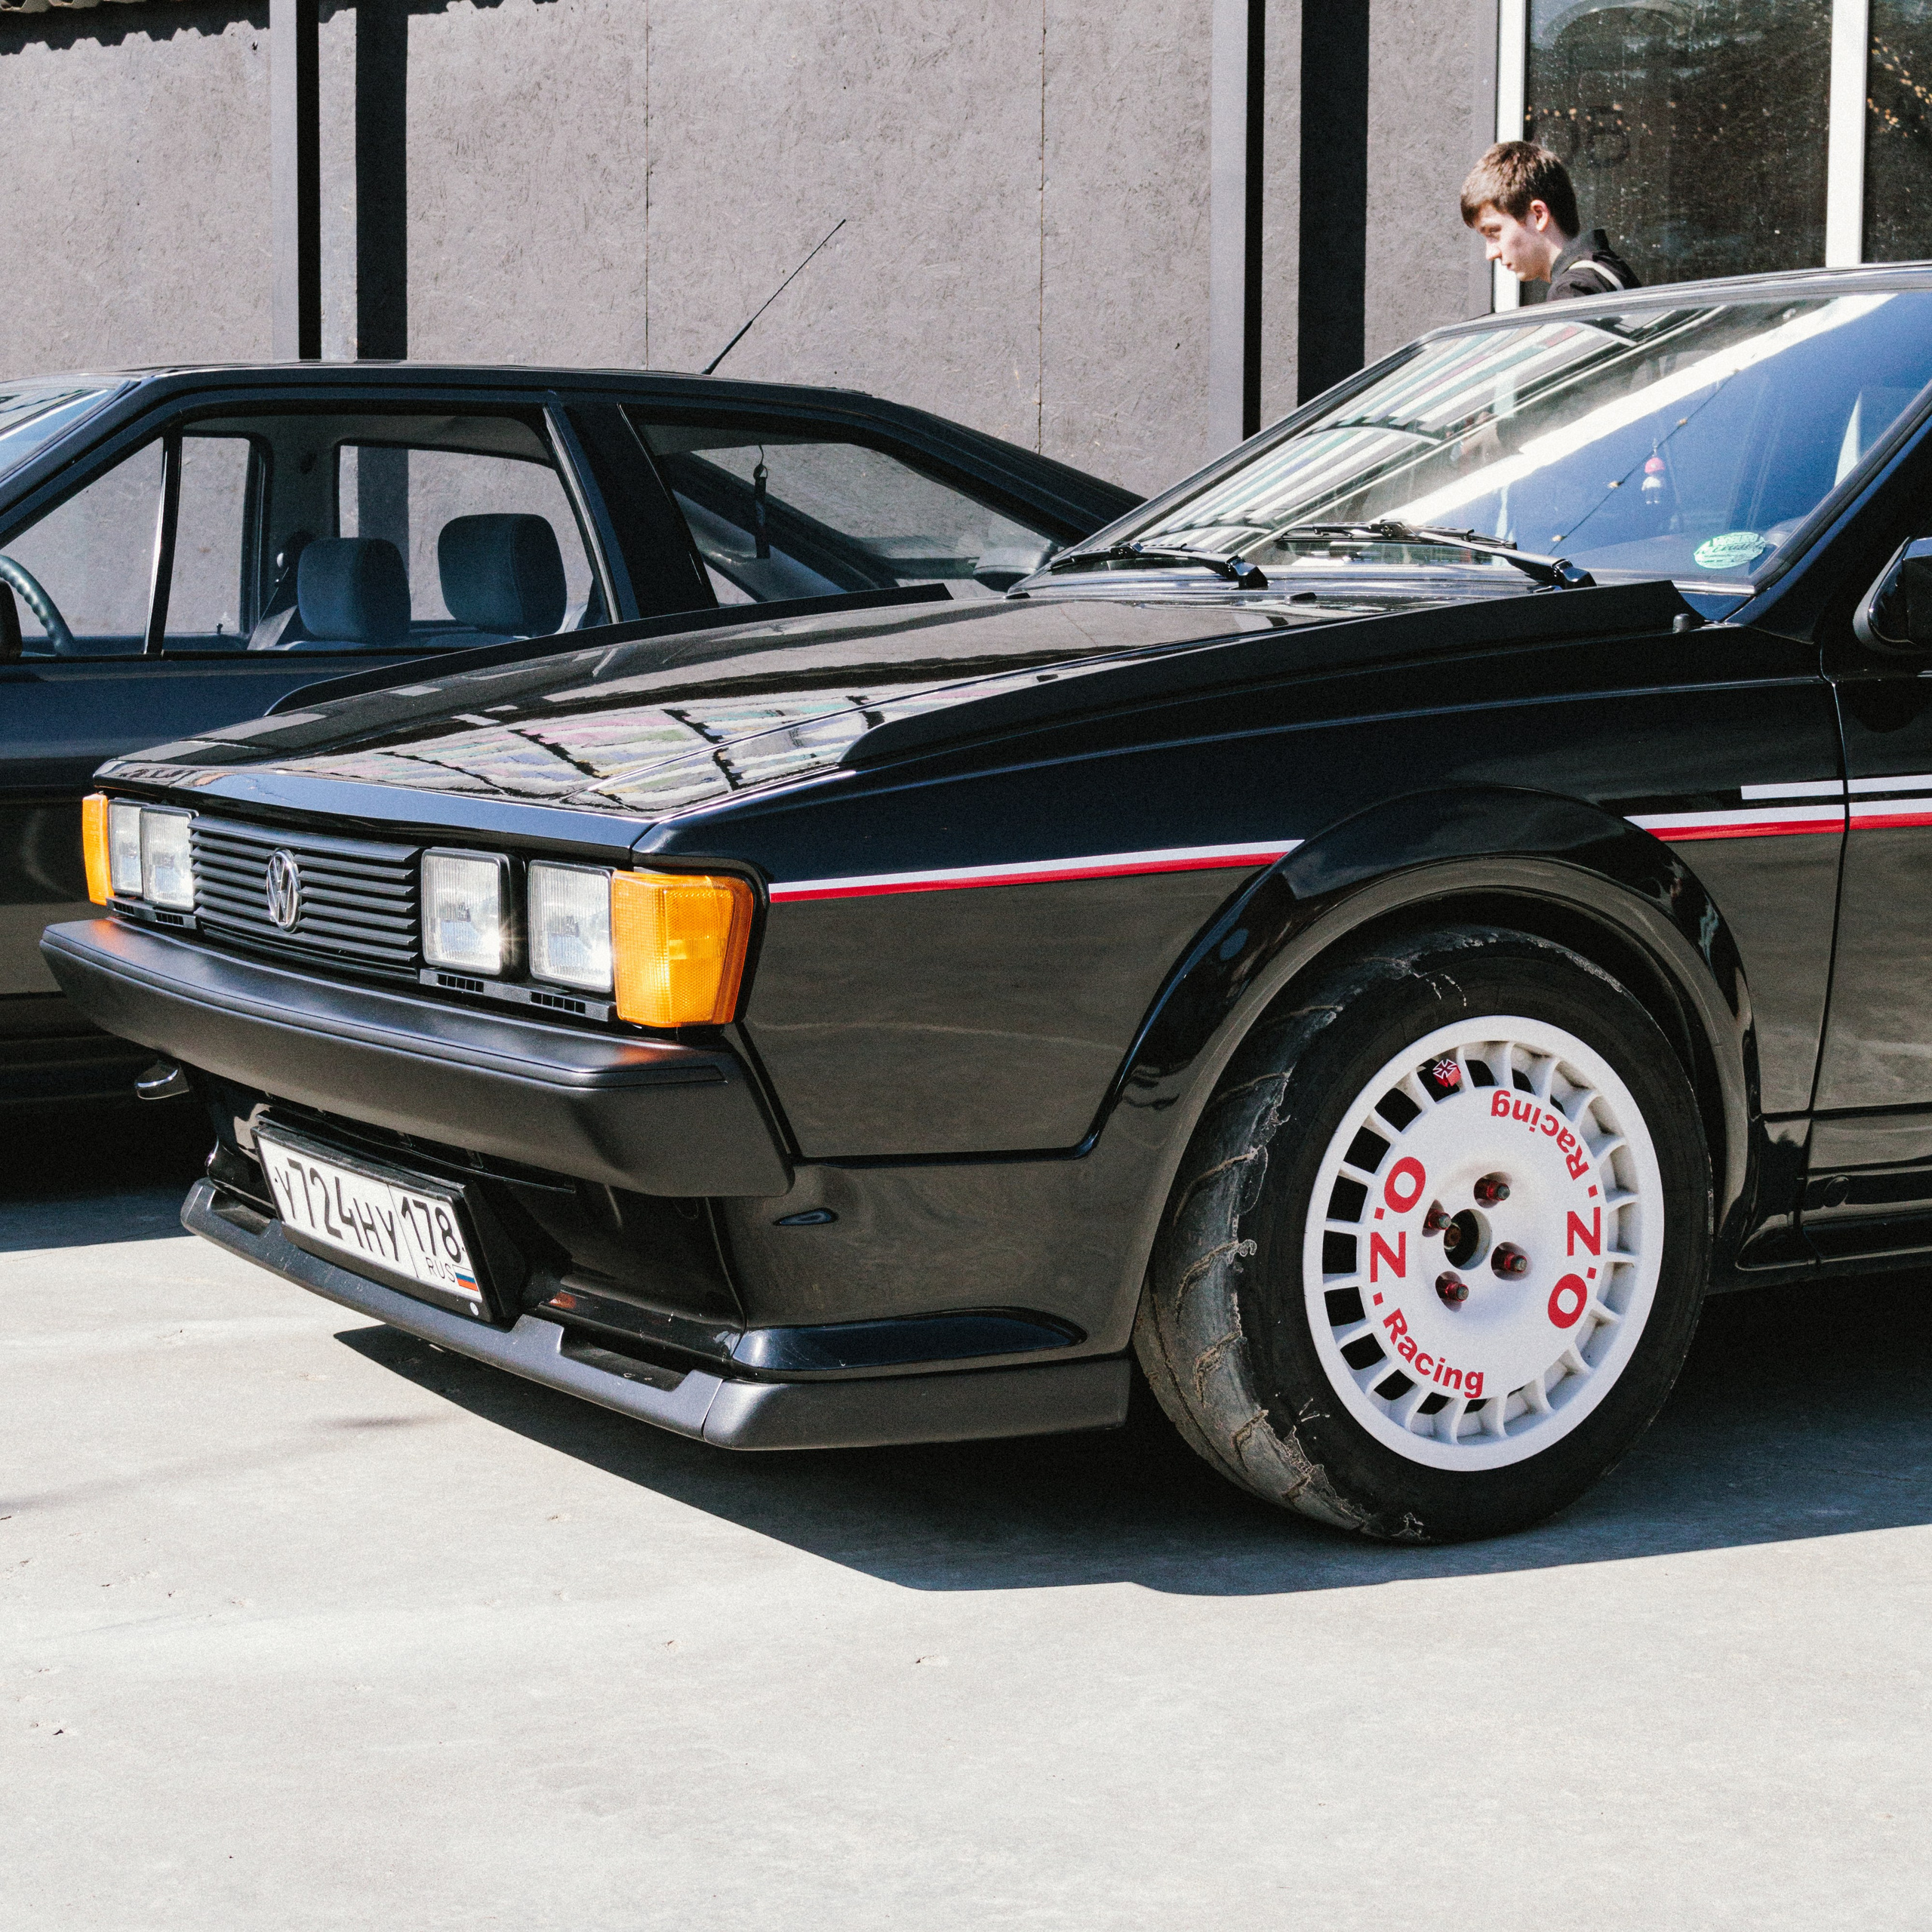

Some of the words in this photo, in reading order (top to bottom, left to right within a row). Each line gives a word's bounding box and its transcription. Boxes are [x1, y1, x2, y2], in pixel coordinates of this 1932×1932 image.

[1491, 1089, 1590, 1181] Racing
[426, 1257, 456, 1283] RUS
[1383, 1308, 1484, 1399] Racing
